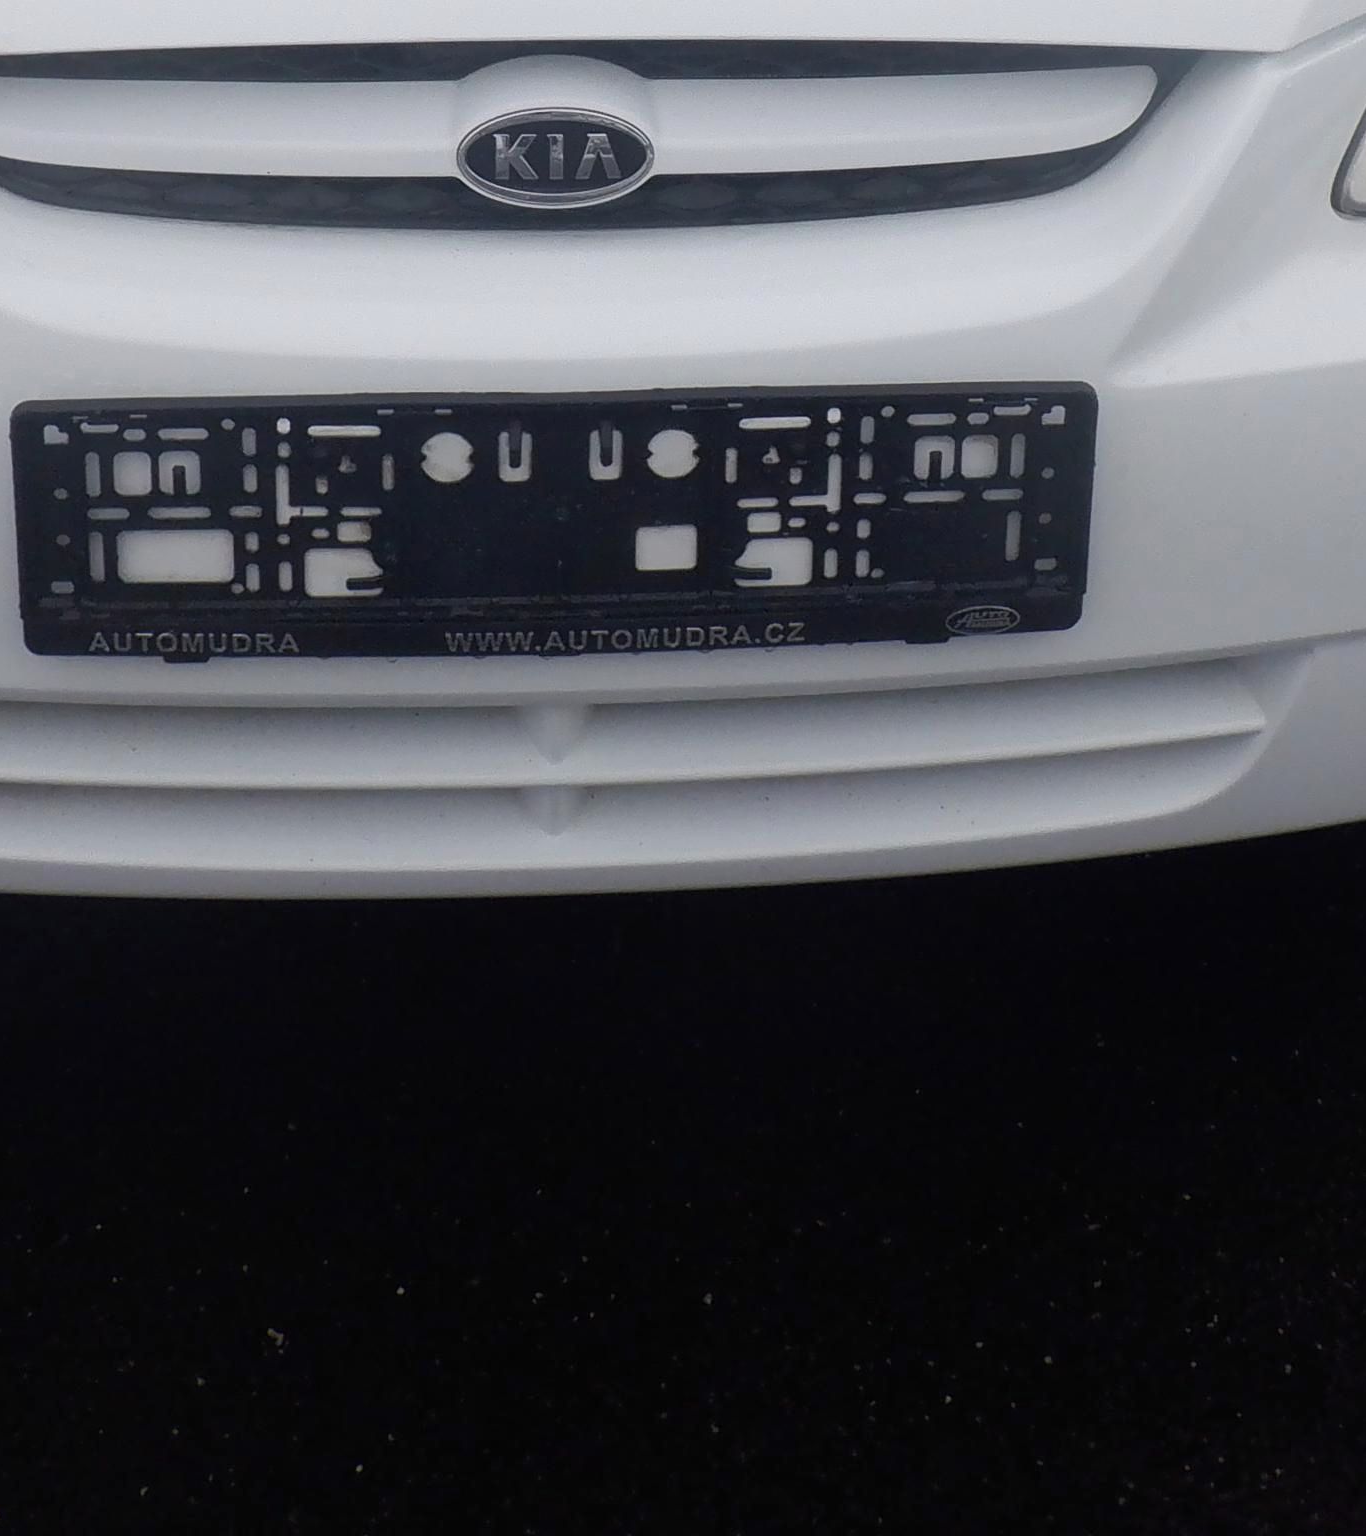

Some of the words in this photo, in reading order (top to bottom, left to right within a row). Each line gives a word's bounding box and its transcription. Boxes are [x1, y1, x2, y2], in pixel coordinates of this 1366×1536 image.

[492, 133, 623, 180] KIA
[88, 631, 300, 653] AUTOMUDRA
[443, 622, 807, 653] WWW.AUTOMUDRA.CZ
